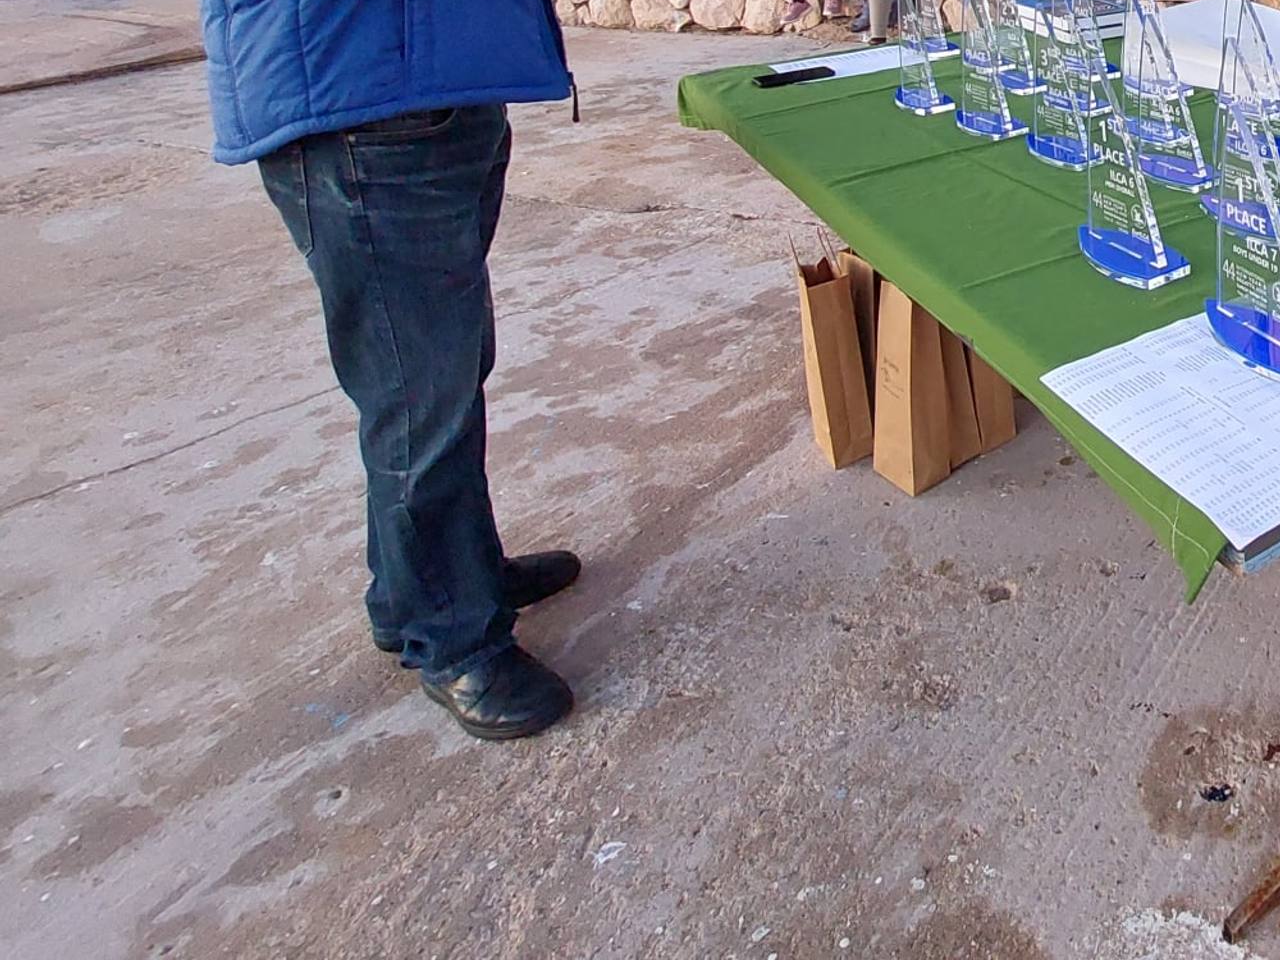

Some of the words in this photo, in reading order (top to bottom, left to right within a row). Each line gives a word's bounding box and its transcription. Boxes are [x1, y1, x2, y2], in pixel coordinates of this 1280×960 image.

[1093, 142, 1126, 167] PLACE
[1109, 169, 1128, 187] ILCA
[1128, 176, 1135, 189] 6
[1235, 176, 1258, 203] 1ST
[1226, 202, 1267, 235] PLACE
[1246, 236, 1269, 259] ILCA
[1270, 247, 1278, 262] 7
[1222, 259, 1236, 281] 44
